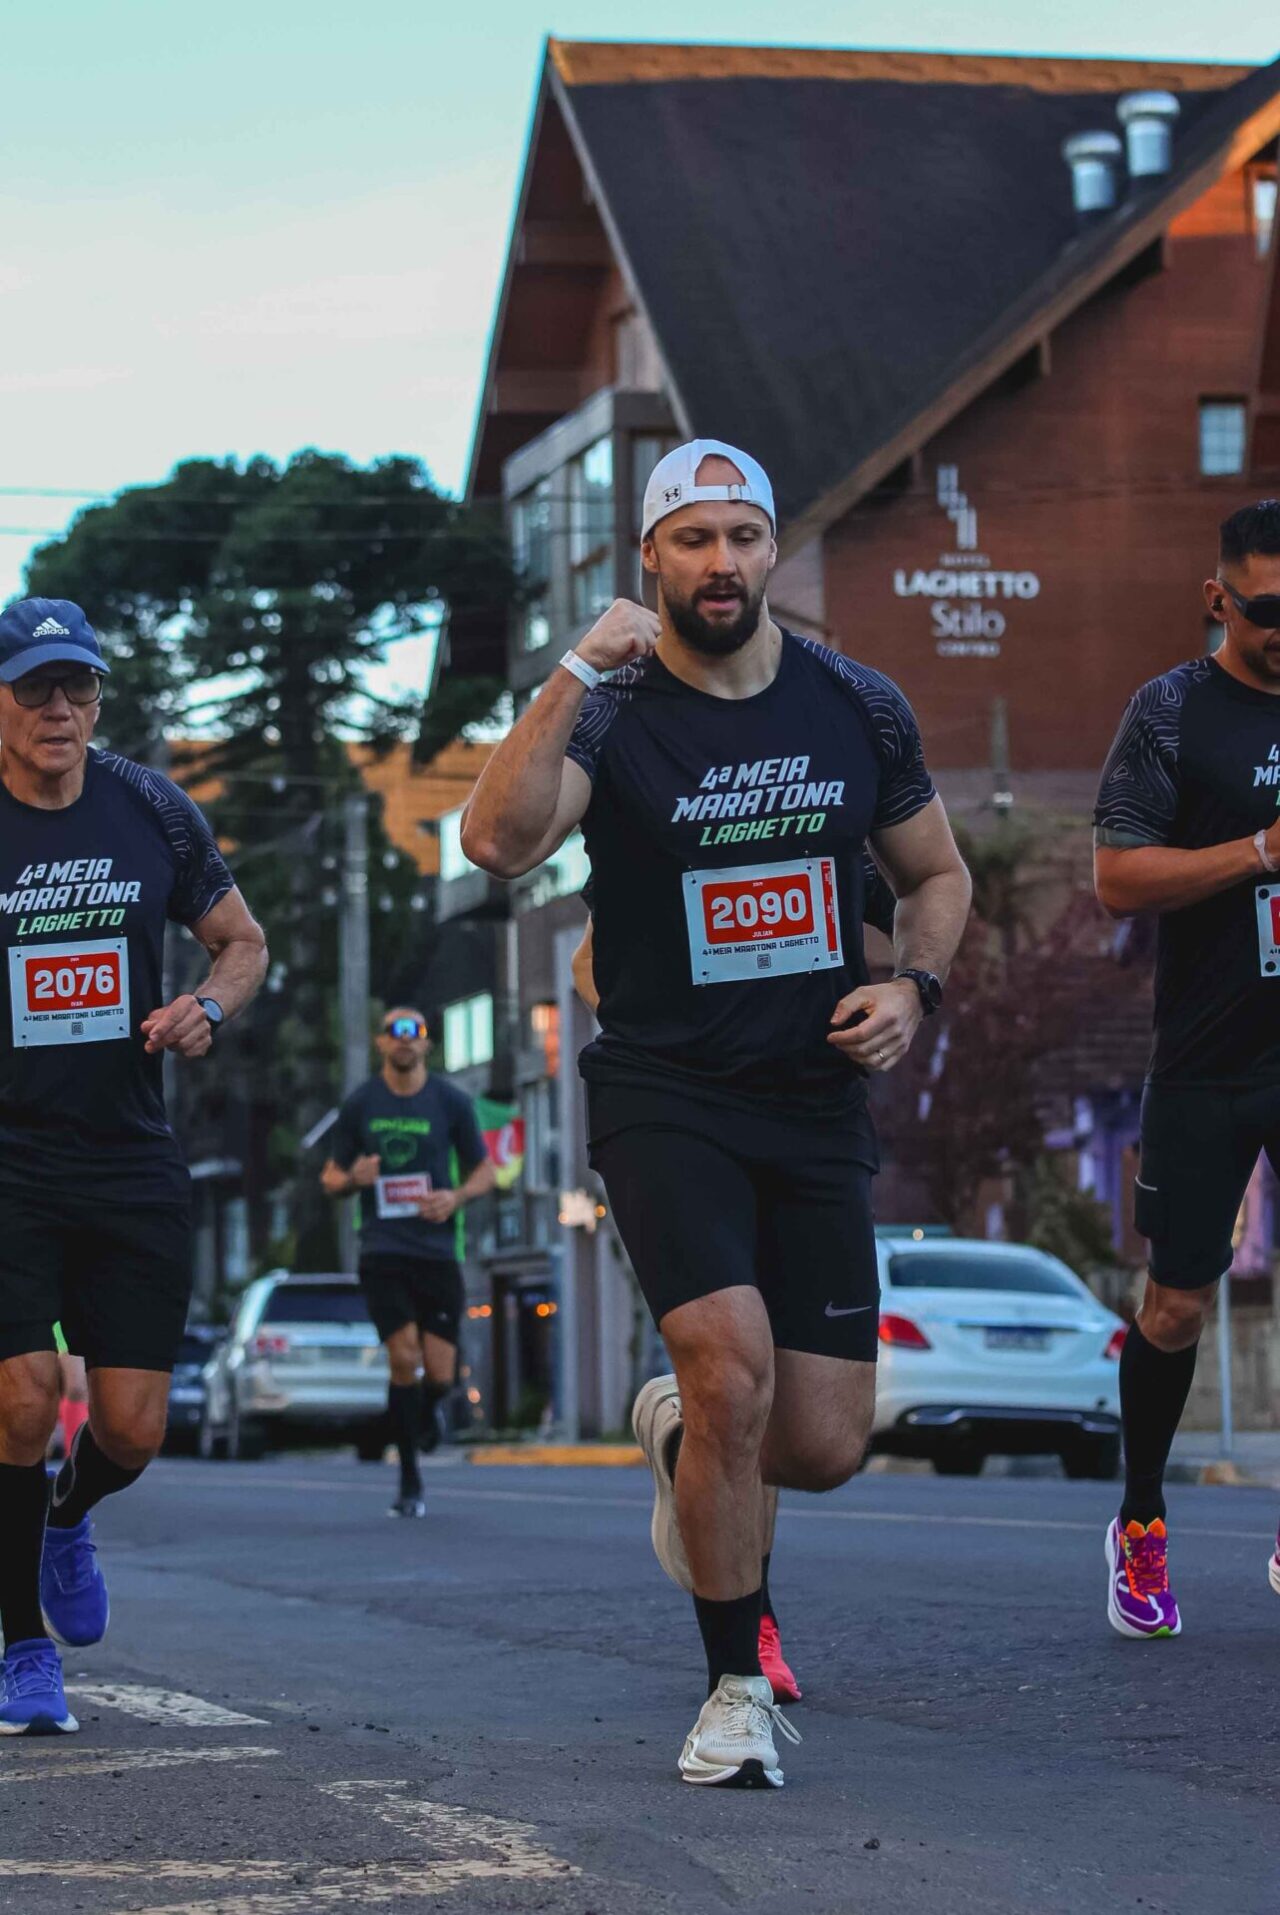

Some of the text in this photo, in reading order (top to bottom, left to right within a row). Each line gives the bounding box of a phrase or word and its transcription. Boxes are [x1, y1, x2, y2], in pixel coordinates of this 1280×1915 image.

[893, 569, 1040, 599] LAGHETTO
[32, 628, 70, 638] adidas
[930, 600, 1006, 639] Stilo
[732, 755, 811, 790] MEIA
[671, 780, 846, 823] MARATONA
[698, 812, 827, 846] LAGHETTO
[46, 858, 113, 885] MEIA
[0, 881, 142, 914] MARATONA
[711, 888, 807, 930] 2090
[16, 908, 126, 936] LAGHETTO
[712, 946, 732, 956] MEIA
[734, 942, 777, 954] MARATONA
[779, 936, 819, 949] LAGHETTO
[34, 964, 115, 999] 2076
[32, 1013, 50, 1022] MEIA
[51, 1011, 89, 1020] MARATONA
[90, 1008, 124, 1018] LAGHETTO
